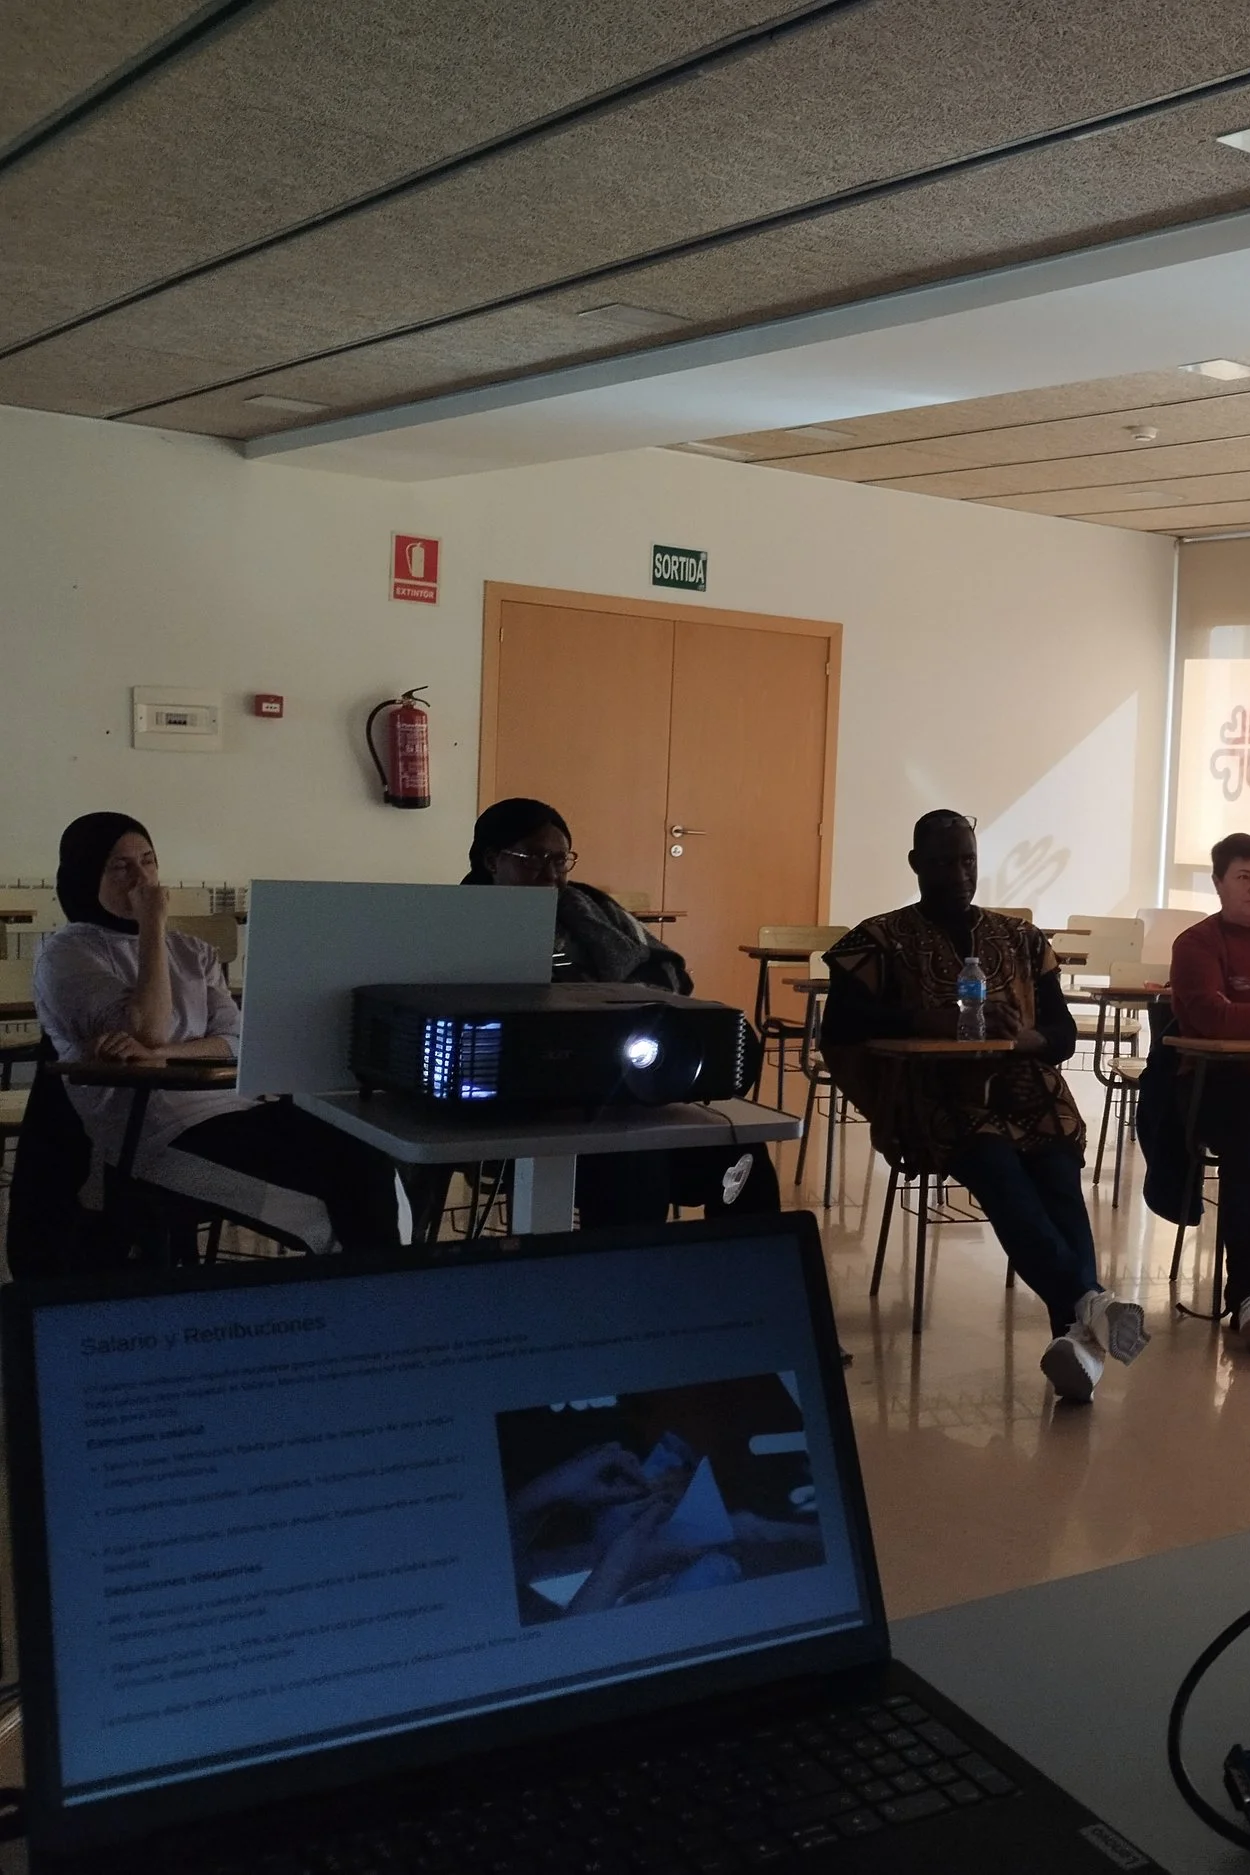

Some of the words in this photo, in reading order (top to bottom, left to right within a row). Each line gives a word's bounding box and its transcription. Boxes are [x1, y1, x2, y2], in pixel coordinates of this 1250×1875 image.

[655, 553, 704, 584] SORTIDA
[395, 586, 435, 600] EXTINTOR
[80, 1333, 158, 1356] Salario
[161, 1332, 179, 1349] y
[184, 1314, 327, 1344] Retribuciones
